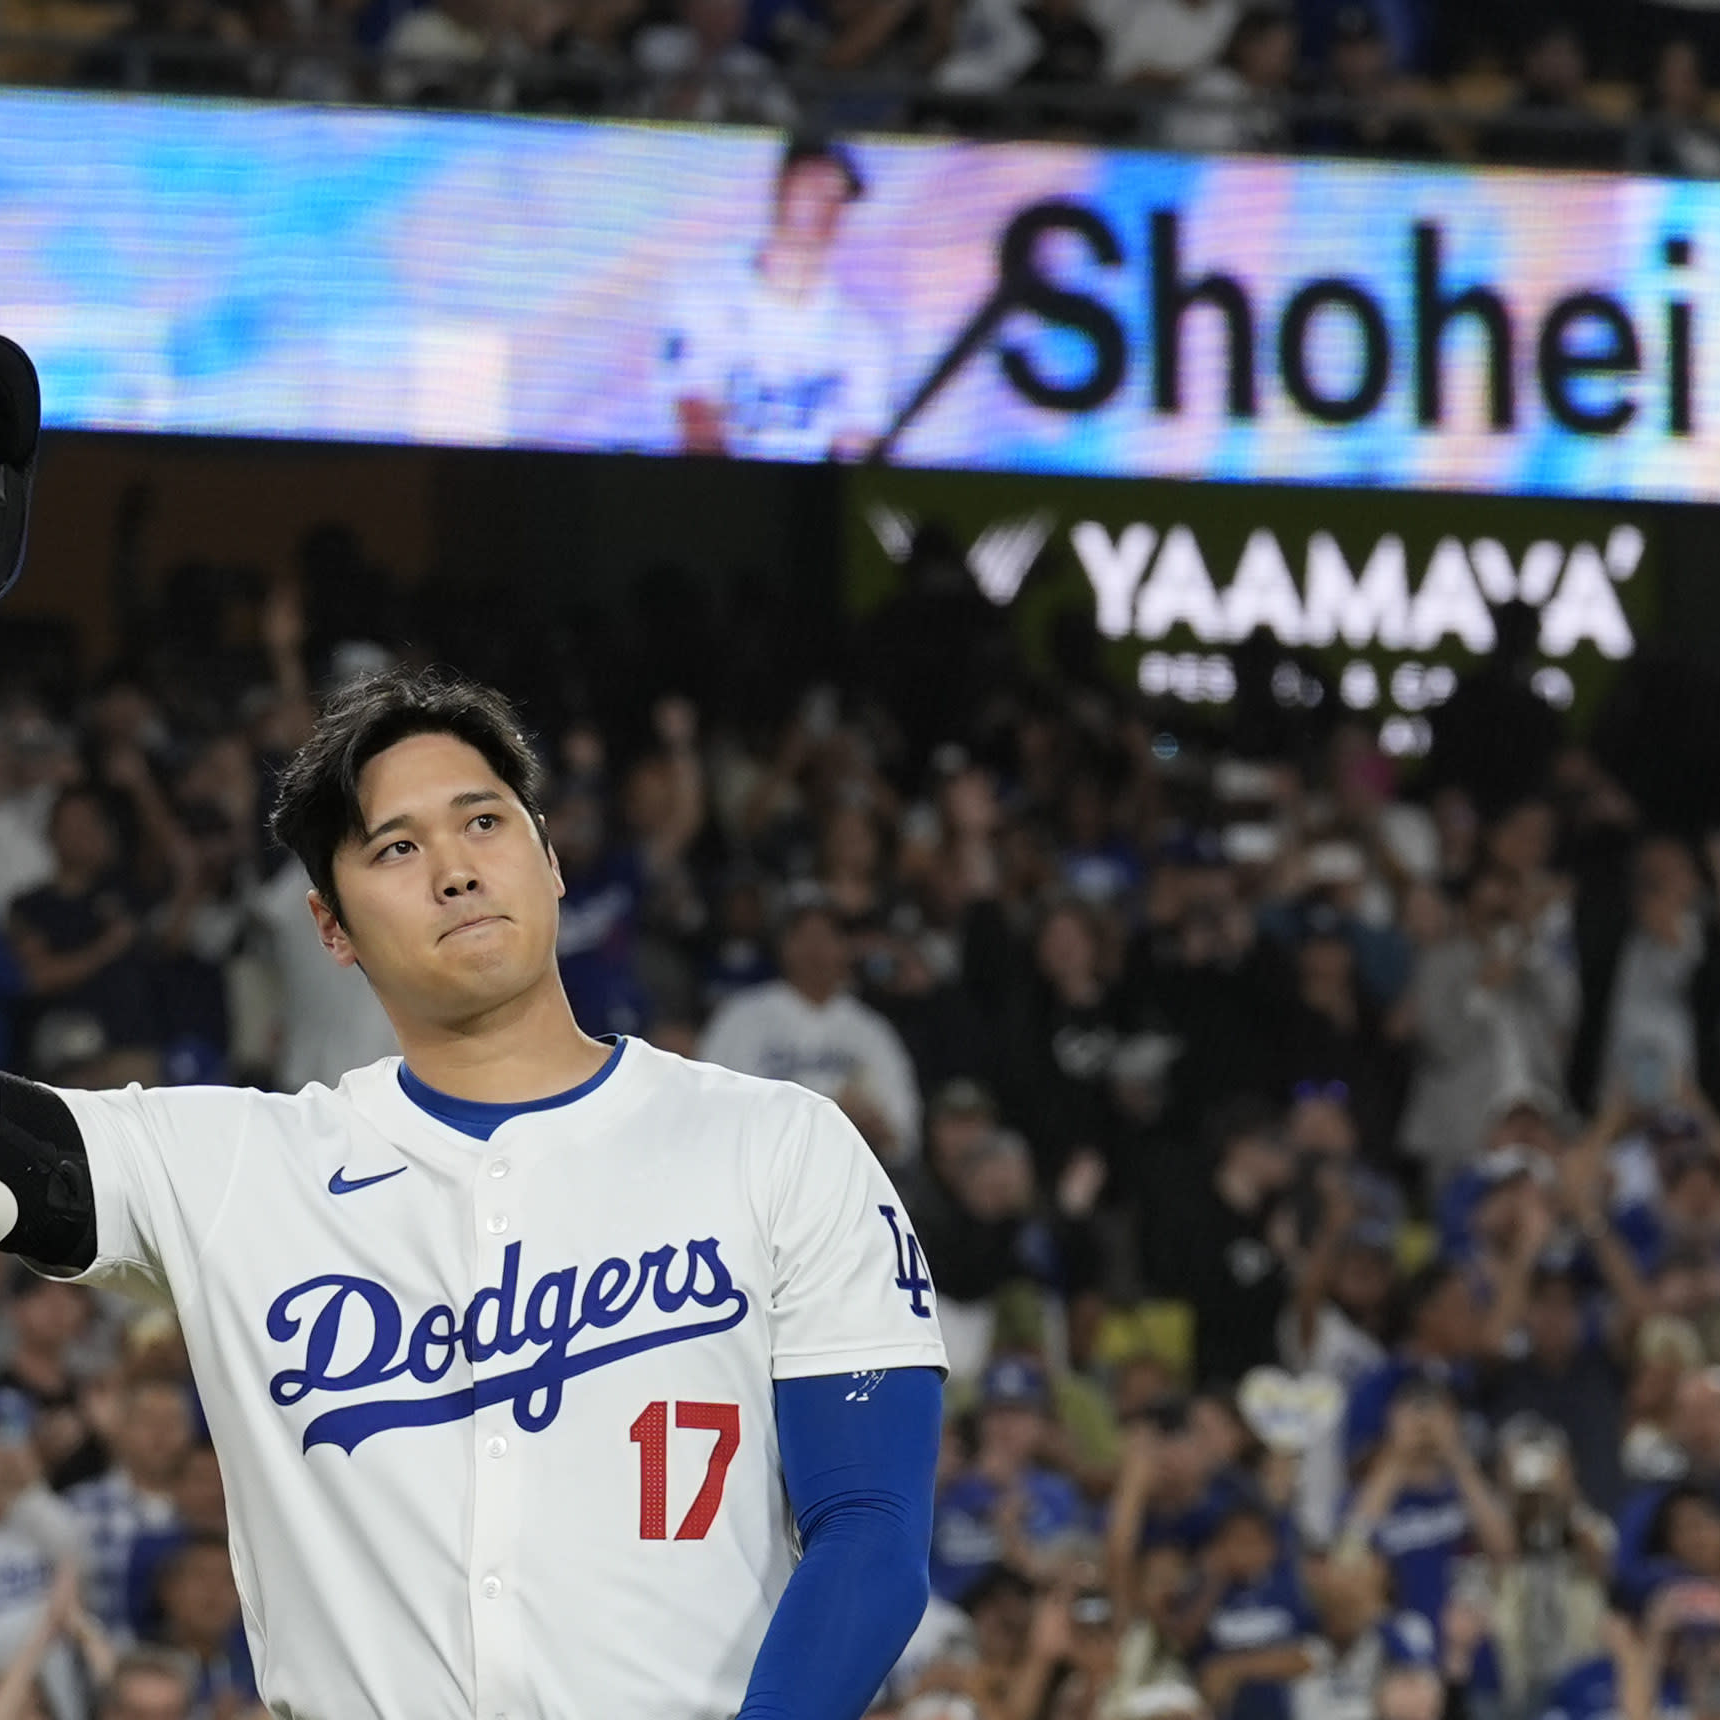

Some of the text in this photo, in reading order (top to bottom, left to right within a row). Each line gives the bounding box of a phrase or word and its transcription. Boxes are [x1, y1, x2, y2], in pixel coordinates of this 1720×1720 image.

[997, 199, 1692, 437] Shohei
[267, 1237, 748, 1453] Dodgers
[879, 1204, 934, 1318] LA
[629, 1401, 741, 1540] 17
